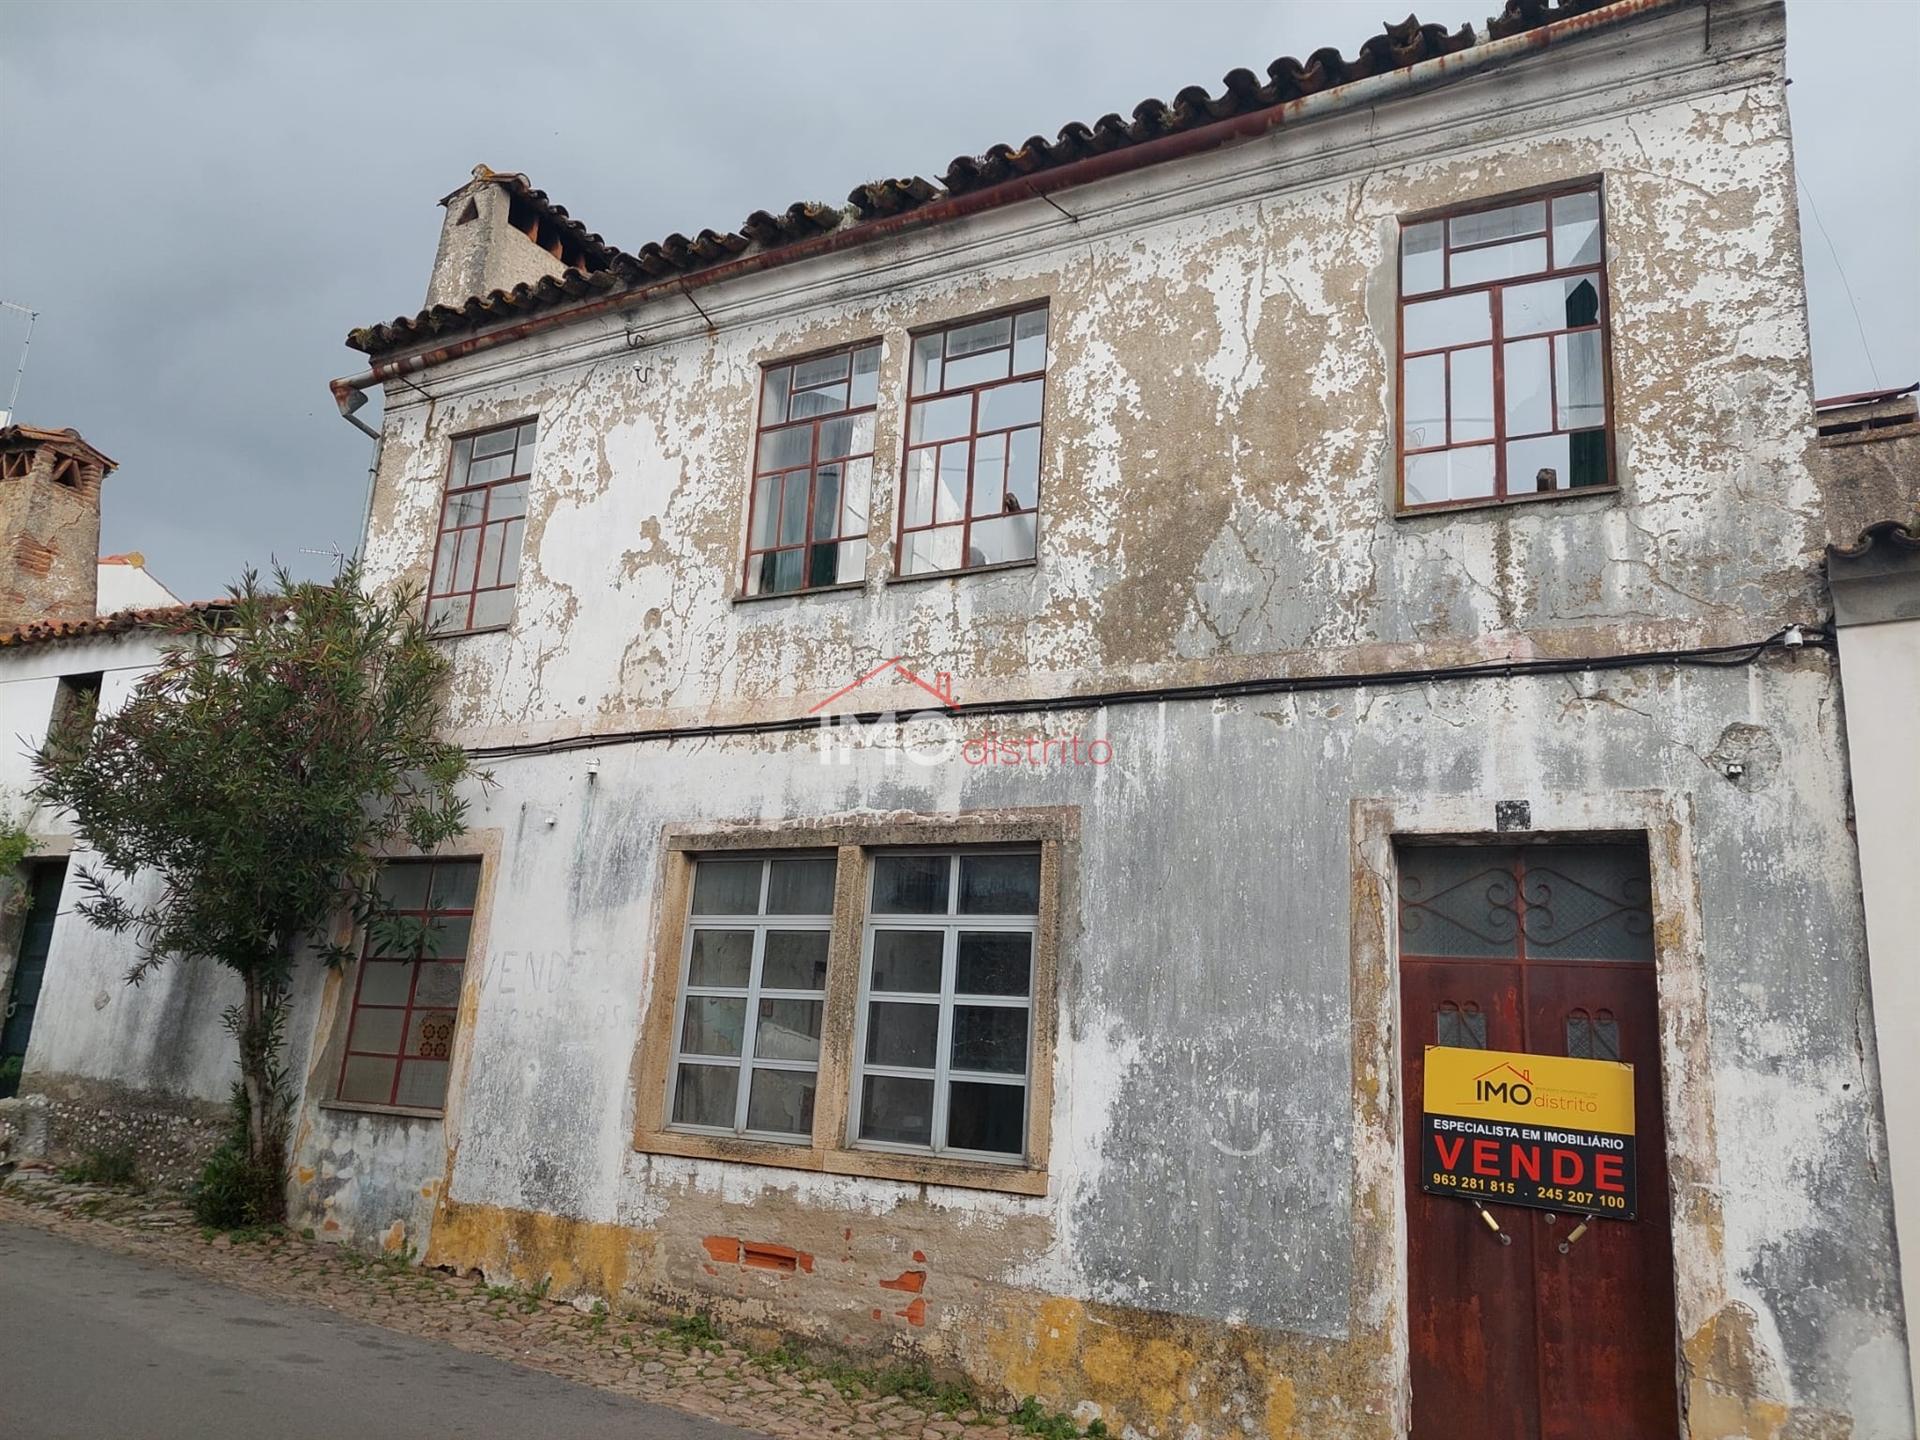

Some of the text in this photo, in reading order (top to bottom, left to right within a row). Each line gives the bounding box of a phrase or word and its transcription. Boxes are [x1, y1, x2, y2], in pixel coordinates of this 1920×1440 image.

[1476, 1079, 1532, 1106] IMO
[1534, 1091, 1598, 1113] distrito
[1433, 1118, 1624, 1150] ESPECIALISTA EM IMOBILIÁRIO
[1433, 1134, 1625, 1192] VENDE
[1432, 1172, 1457, 1187] 963
[1461, 1176, 1485, 1191] 281
[1489, 1180, 1516, 1195] 815
[1537, 1186, 1564, 1201] 245
[1567, 1190, 1594, 1205] 207
[1599, 1194, 1626, 1209] 100
